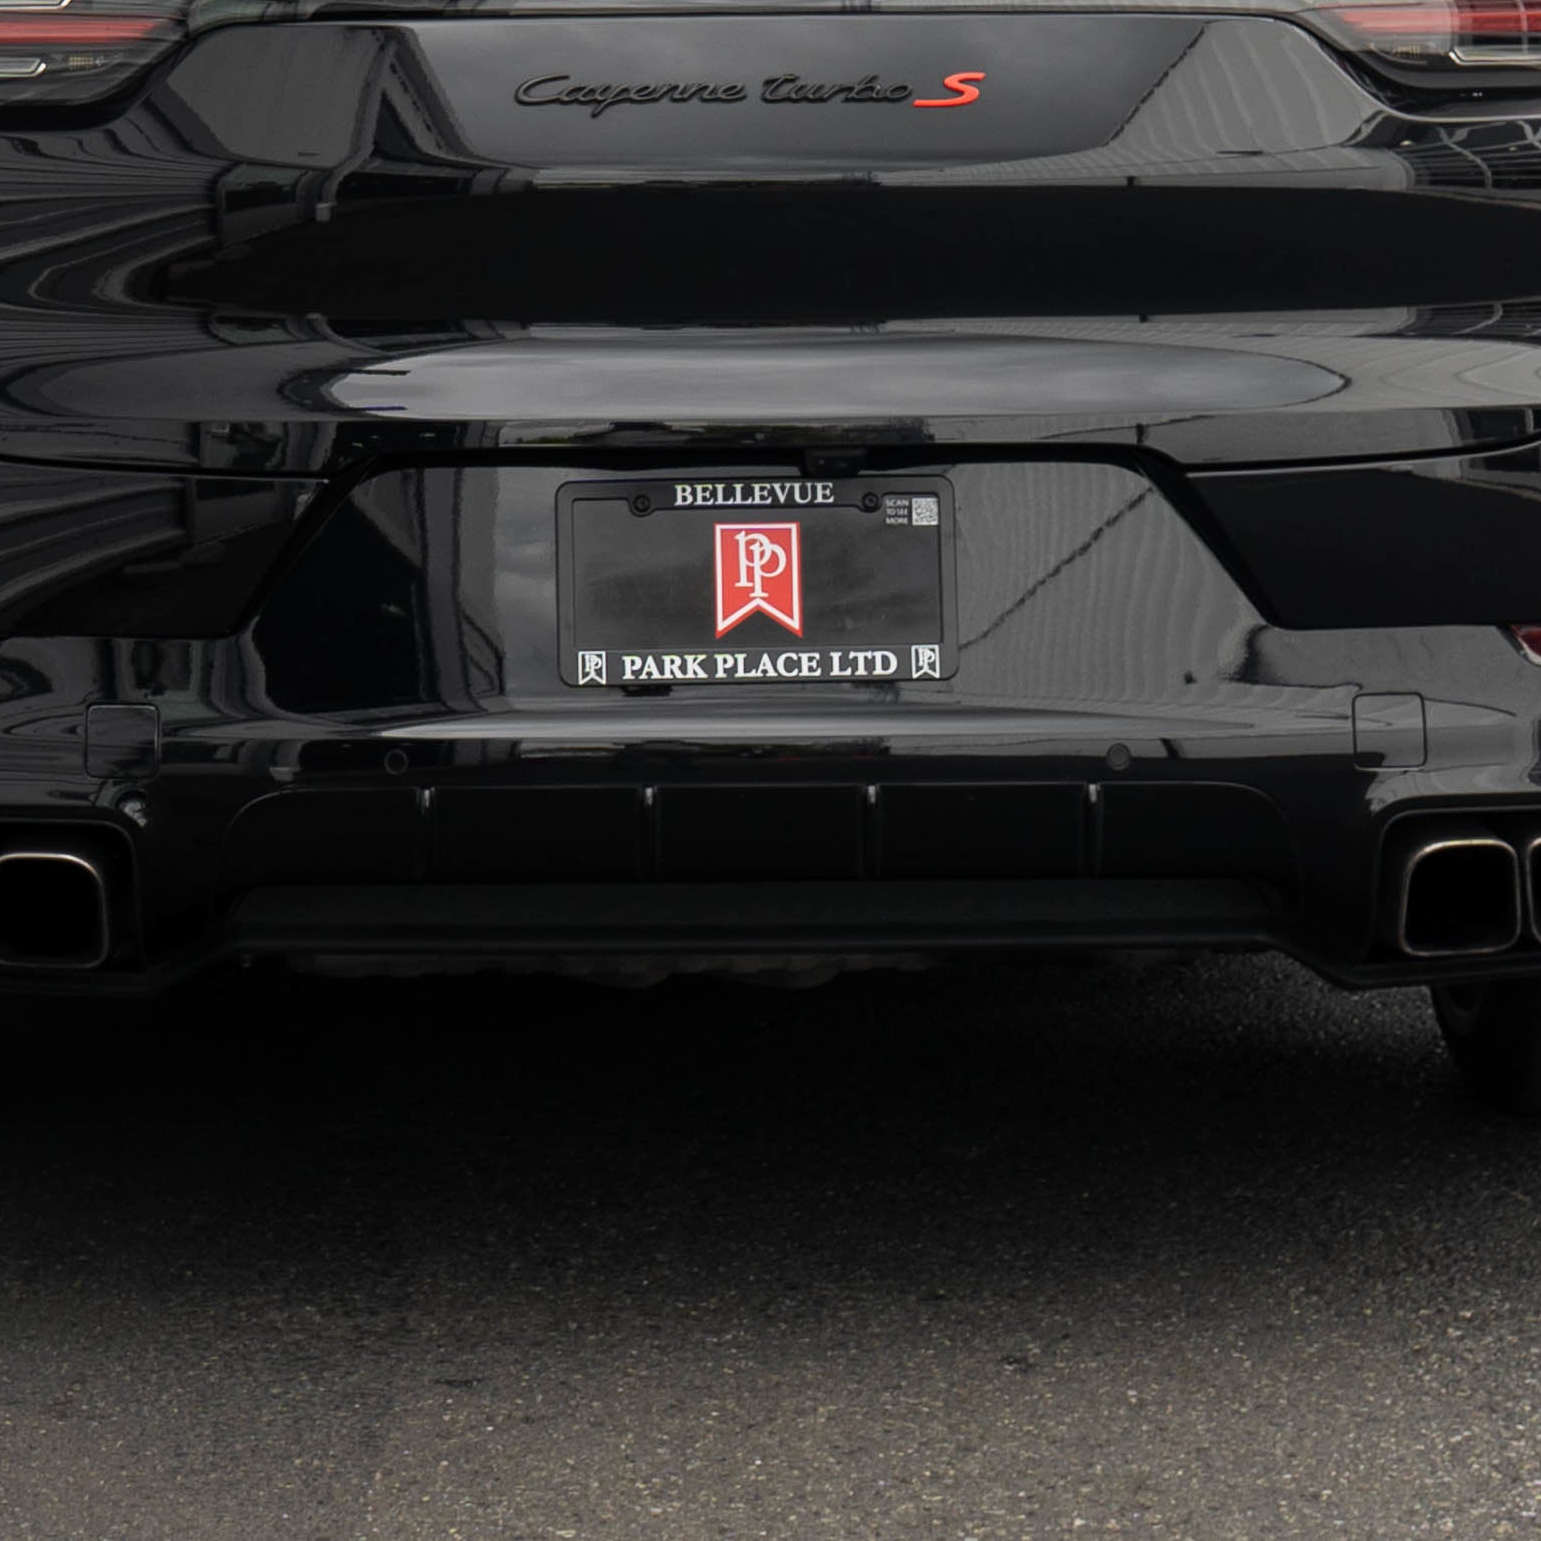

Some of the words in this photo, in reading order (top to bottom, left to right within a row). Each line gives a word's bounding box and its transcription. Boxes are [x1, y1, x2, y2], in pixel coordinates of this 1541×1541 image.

[513, 74, 748, 118] Cayenne
[913, 72, 986, 107] S
[674, 482, 835, 507] BELLEVUE
[622, 656, 709, 679] PARK
[714, 652, 822, 678] PLACE
[829, 651, 898, 677] LTD
